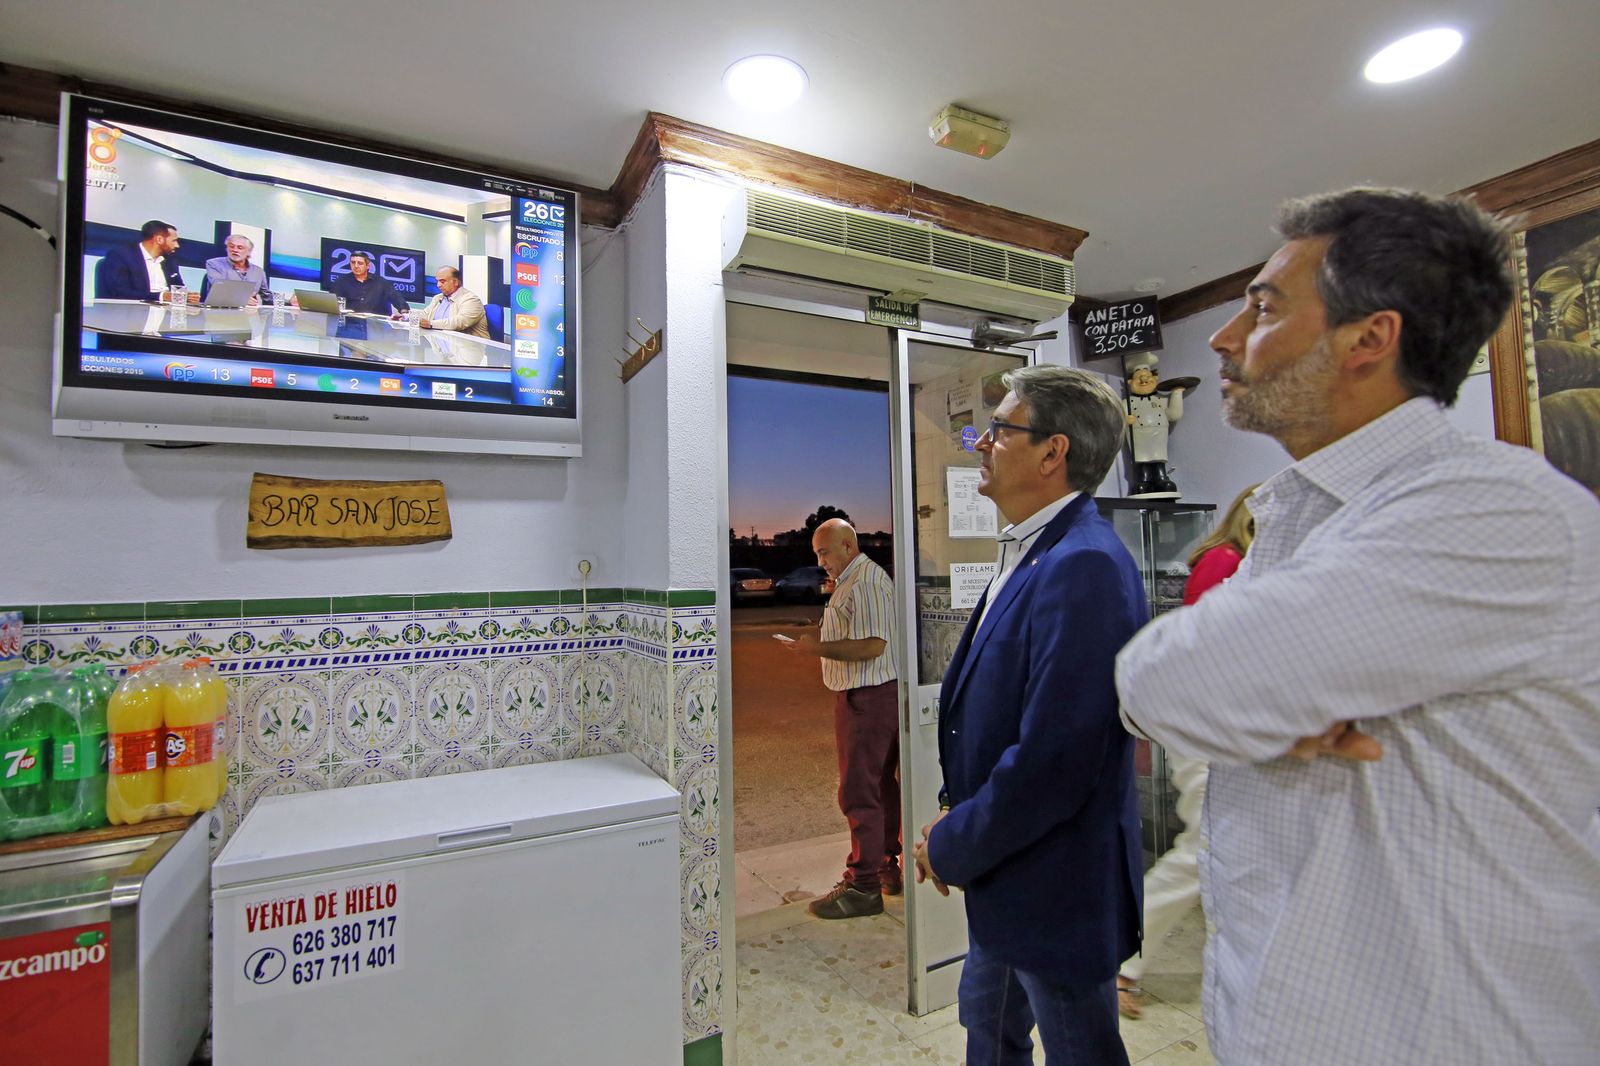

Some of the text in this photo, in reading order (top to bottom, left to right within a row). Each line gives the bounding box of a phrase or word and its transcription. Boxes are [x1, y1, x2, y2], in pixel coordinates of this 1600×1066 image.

[523, 201, 549, 220] 26
[517, 232, 560, 245] ESCRUTADO
[556, 251, 564, 261] 8
[517, 272, 538, 281] PSOE
[393, 283, 415, 292] 2019
[875, 299, 912, 313] SALIDA DE
[871, 310, 918, 327] EMERGENCIA
[1085, 303, 1144, 324] ANETO
[556, 323, 564, 332] 4
[1085, 314, 1154, 336] CON PATATA
[557, 346, 564, 356] 3
[124, 367, 144, 375] 2015
[211, 368, 231, 381] 13
[252, 376, 273, 384] PSOE
[287, 374, 297, 385] 5
[350, 379, 359, 390] 2
[409, 383, 418, 394] 2
[464, 387, 473, 398] 2
[541, 397, 554, 406] 14
[261, 494, 441, 531] BAR SAN JOSE
[954, 565, 995, 573] ORIFLAME
[246, 881, 397, 933] VENTA DE HIELO
[293, 916, 397, 955] 626 380 717
[0, 944, 106, 981] zcampo
[293, 944, 395, 984] 637 711 401
